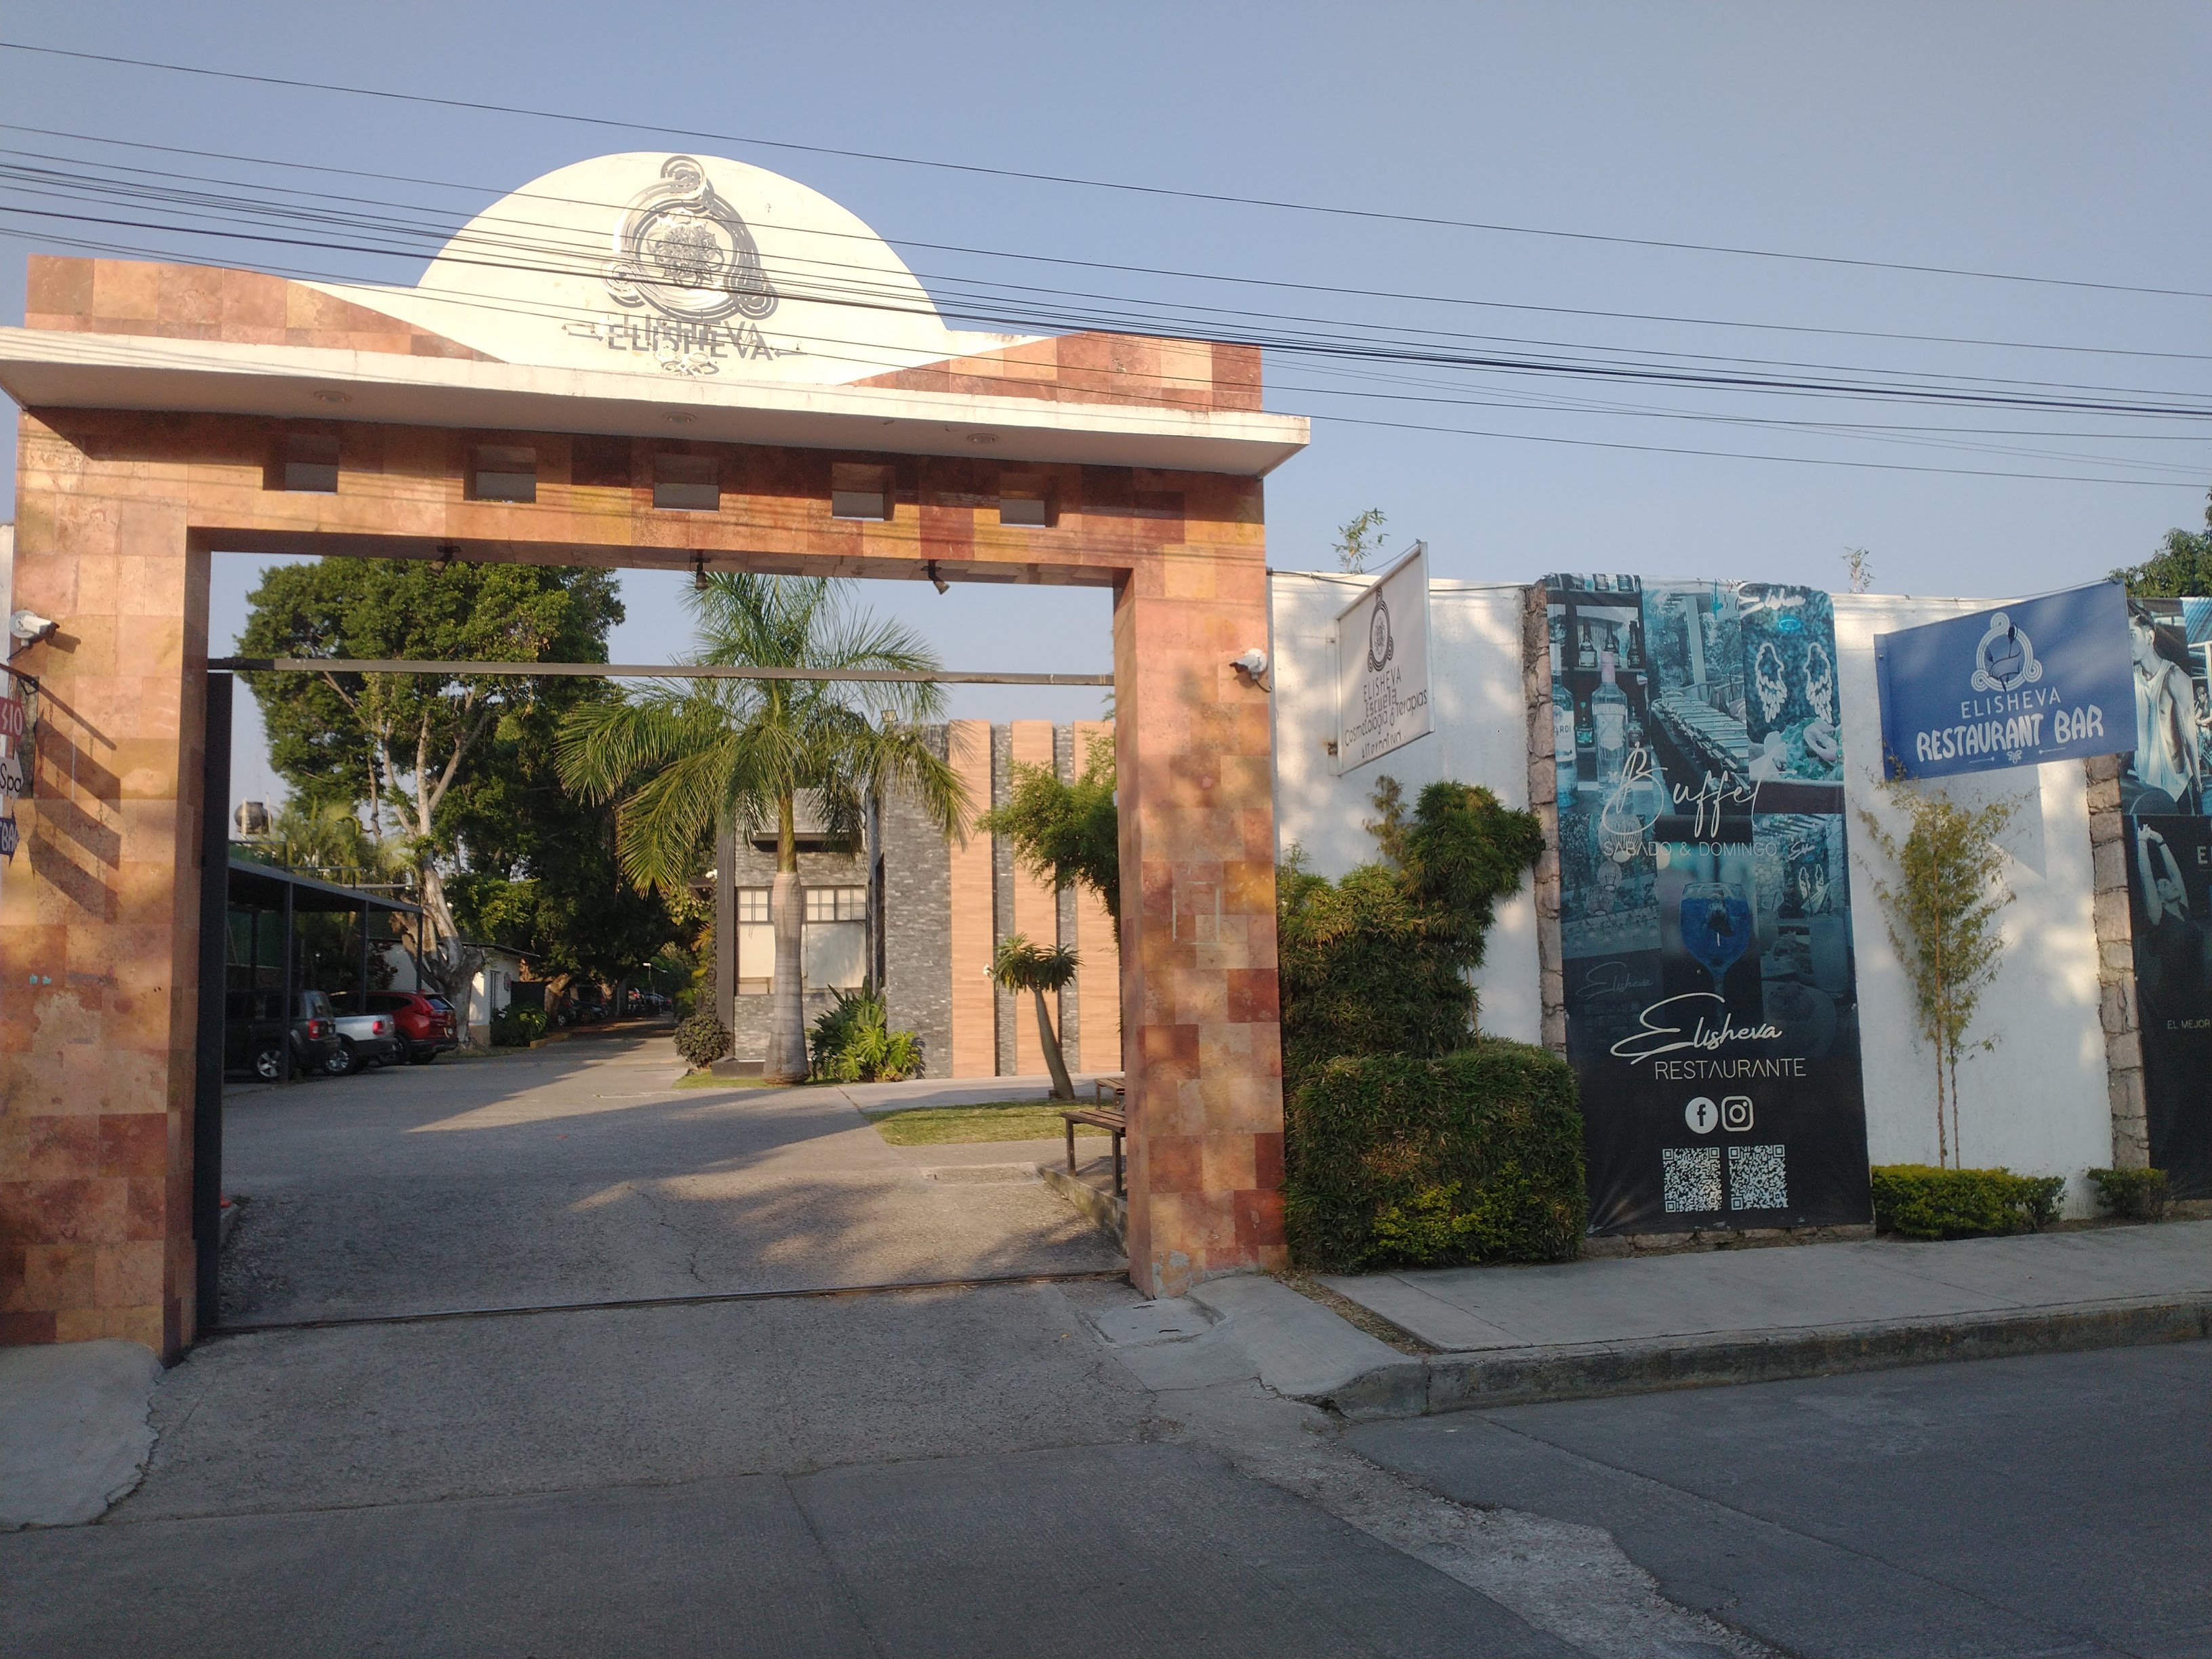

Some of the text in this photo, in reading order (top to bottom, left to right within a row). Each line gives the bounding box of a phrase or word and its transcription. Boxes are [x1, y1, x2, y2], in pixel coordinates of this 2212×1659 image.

[607, 312, 774, 361] ELISHEVA
[1363, 665, 1401, 703] ELISHEVA
[1395, 689, 1428, 716] Terapias
[1961, 687, 2061, 719] ELISHEVA
[1917, 704, 2104, 762] RESTAURANT BAR
[1603, 840, 1672, 857] SABADO
[1680, 840, 1692, 857] &
[1699, 840, 1777, 857] DOMINGO
[1610, 992, 1782, 1065] Elisheva
[2167, 1019, 2211, 1029] EL MEJOR
[1654, 1058, 1807, 1080] RESTAURANTE
